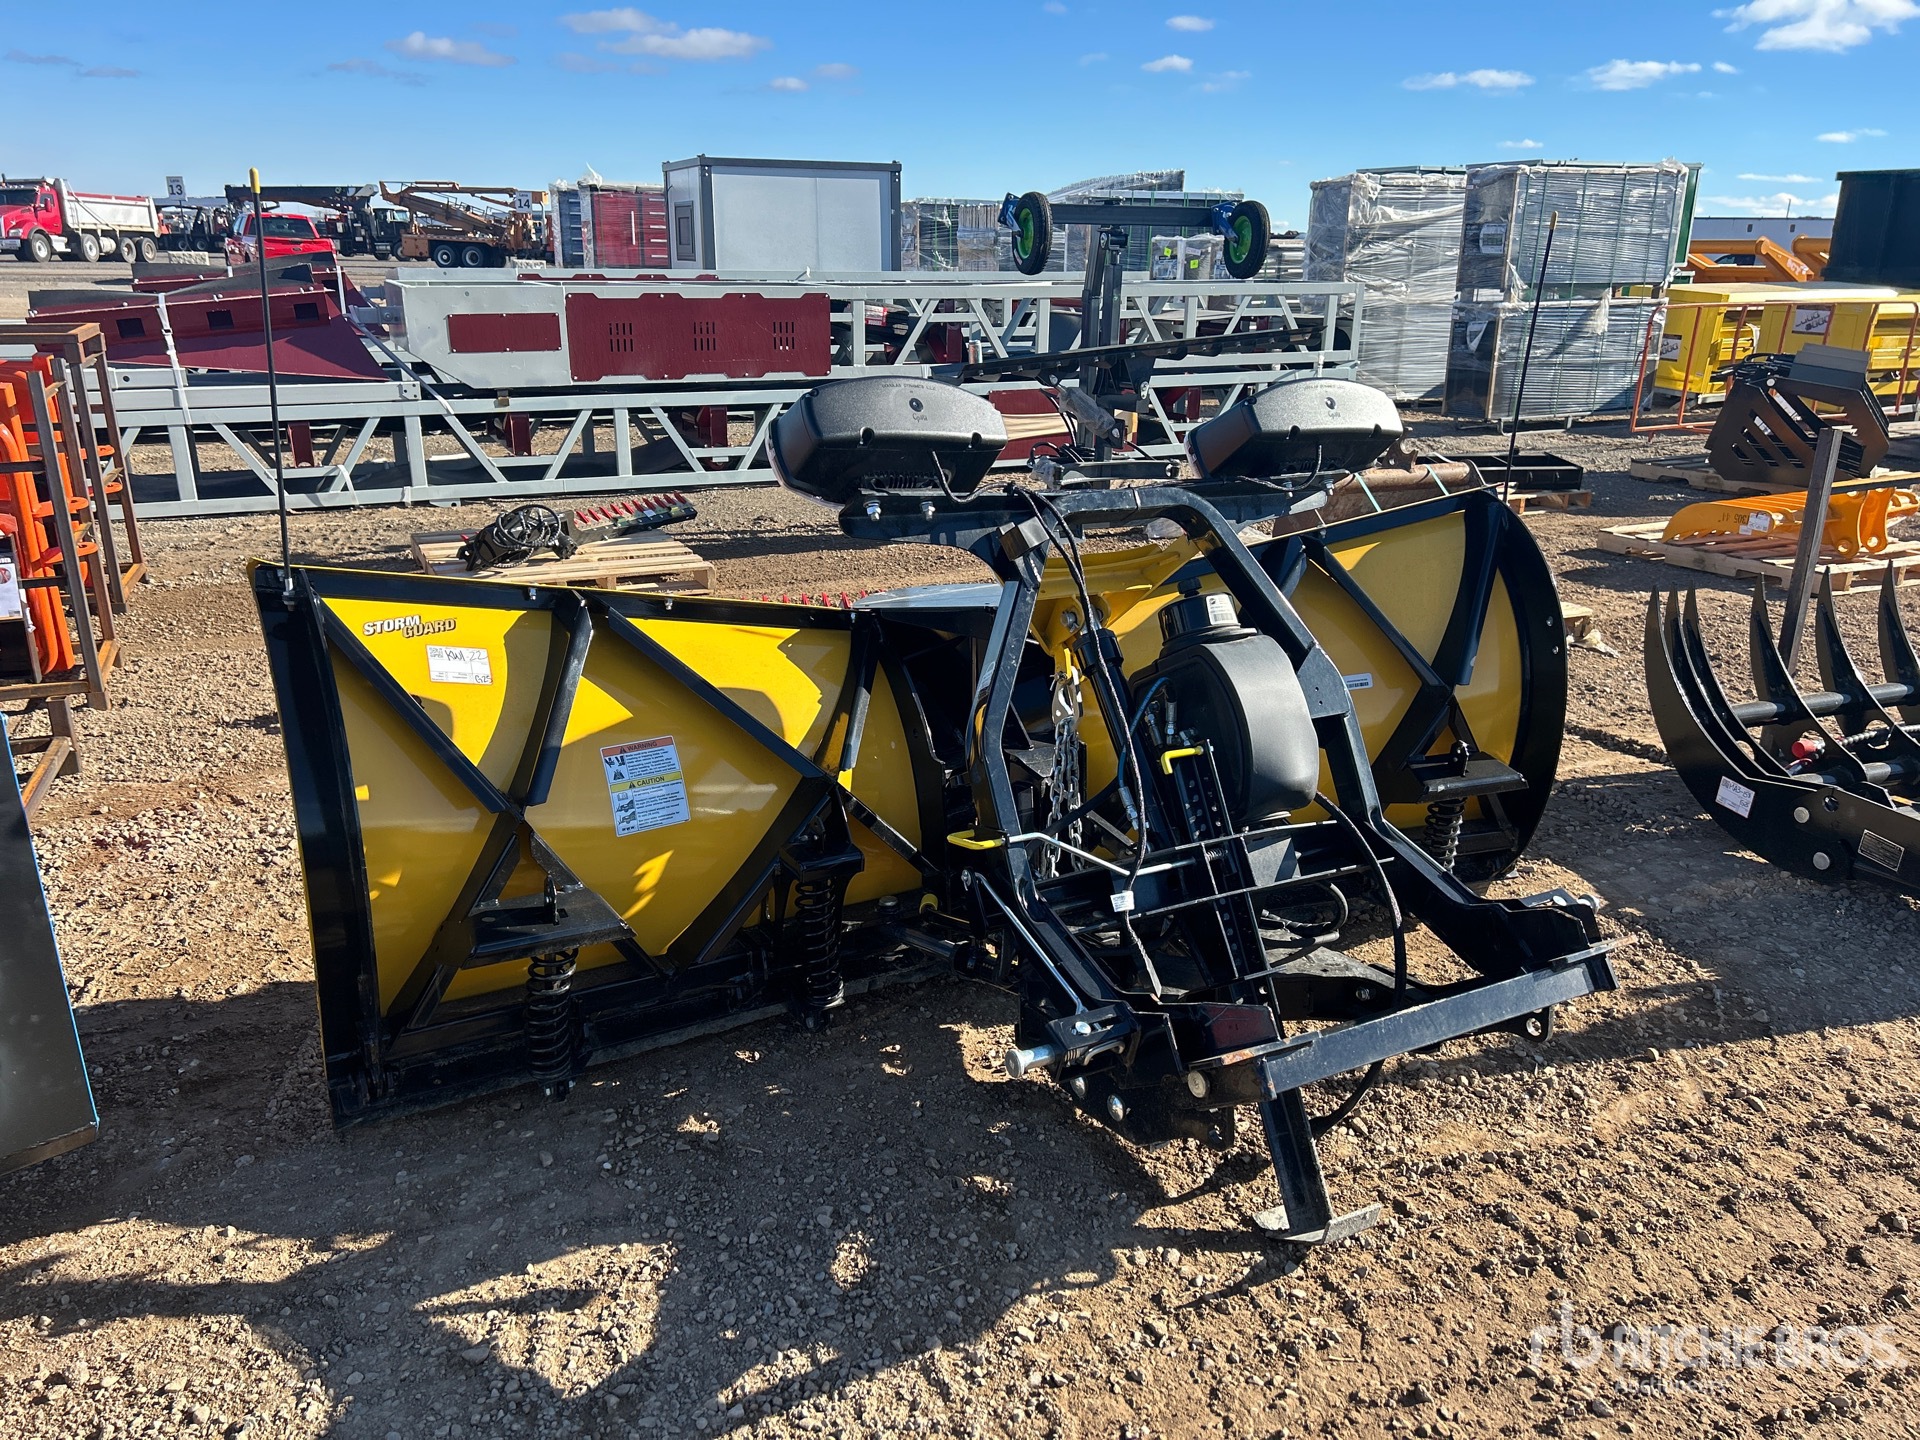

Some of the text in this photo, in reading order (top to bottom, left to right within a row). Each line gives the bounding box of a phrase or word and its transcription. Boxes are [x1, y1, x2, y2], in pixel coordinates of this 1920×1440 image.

[169, 184, 183, 196] 13
[518, 199, 530, 209] 14
[363, 614, 457, 639] STORM GUARD
[627, 741, 658, 752] WARNING
[637, 776, 665, 787] CAUTION
